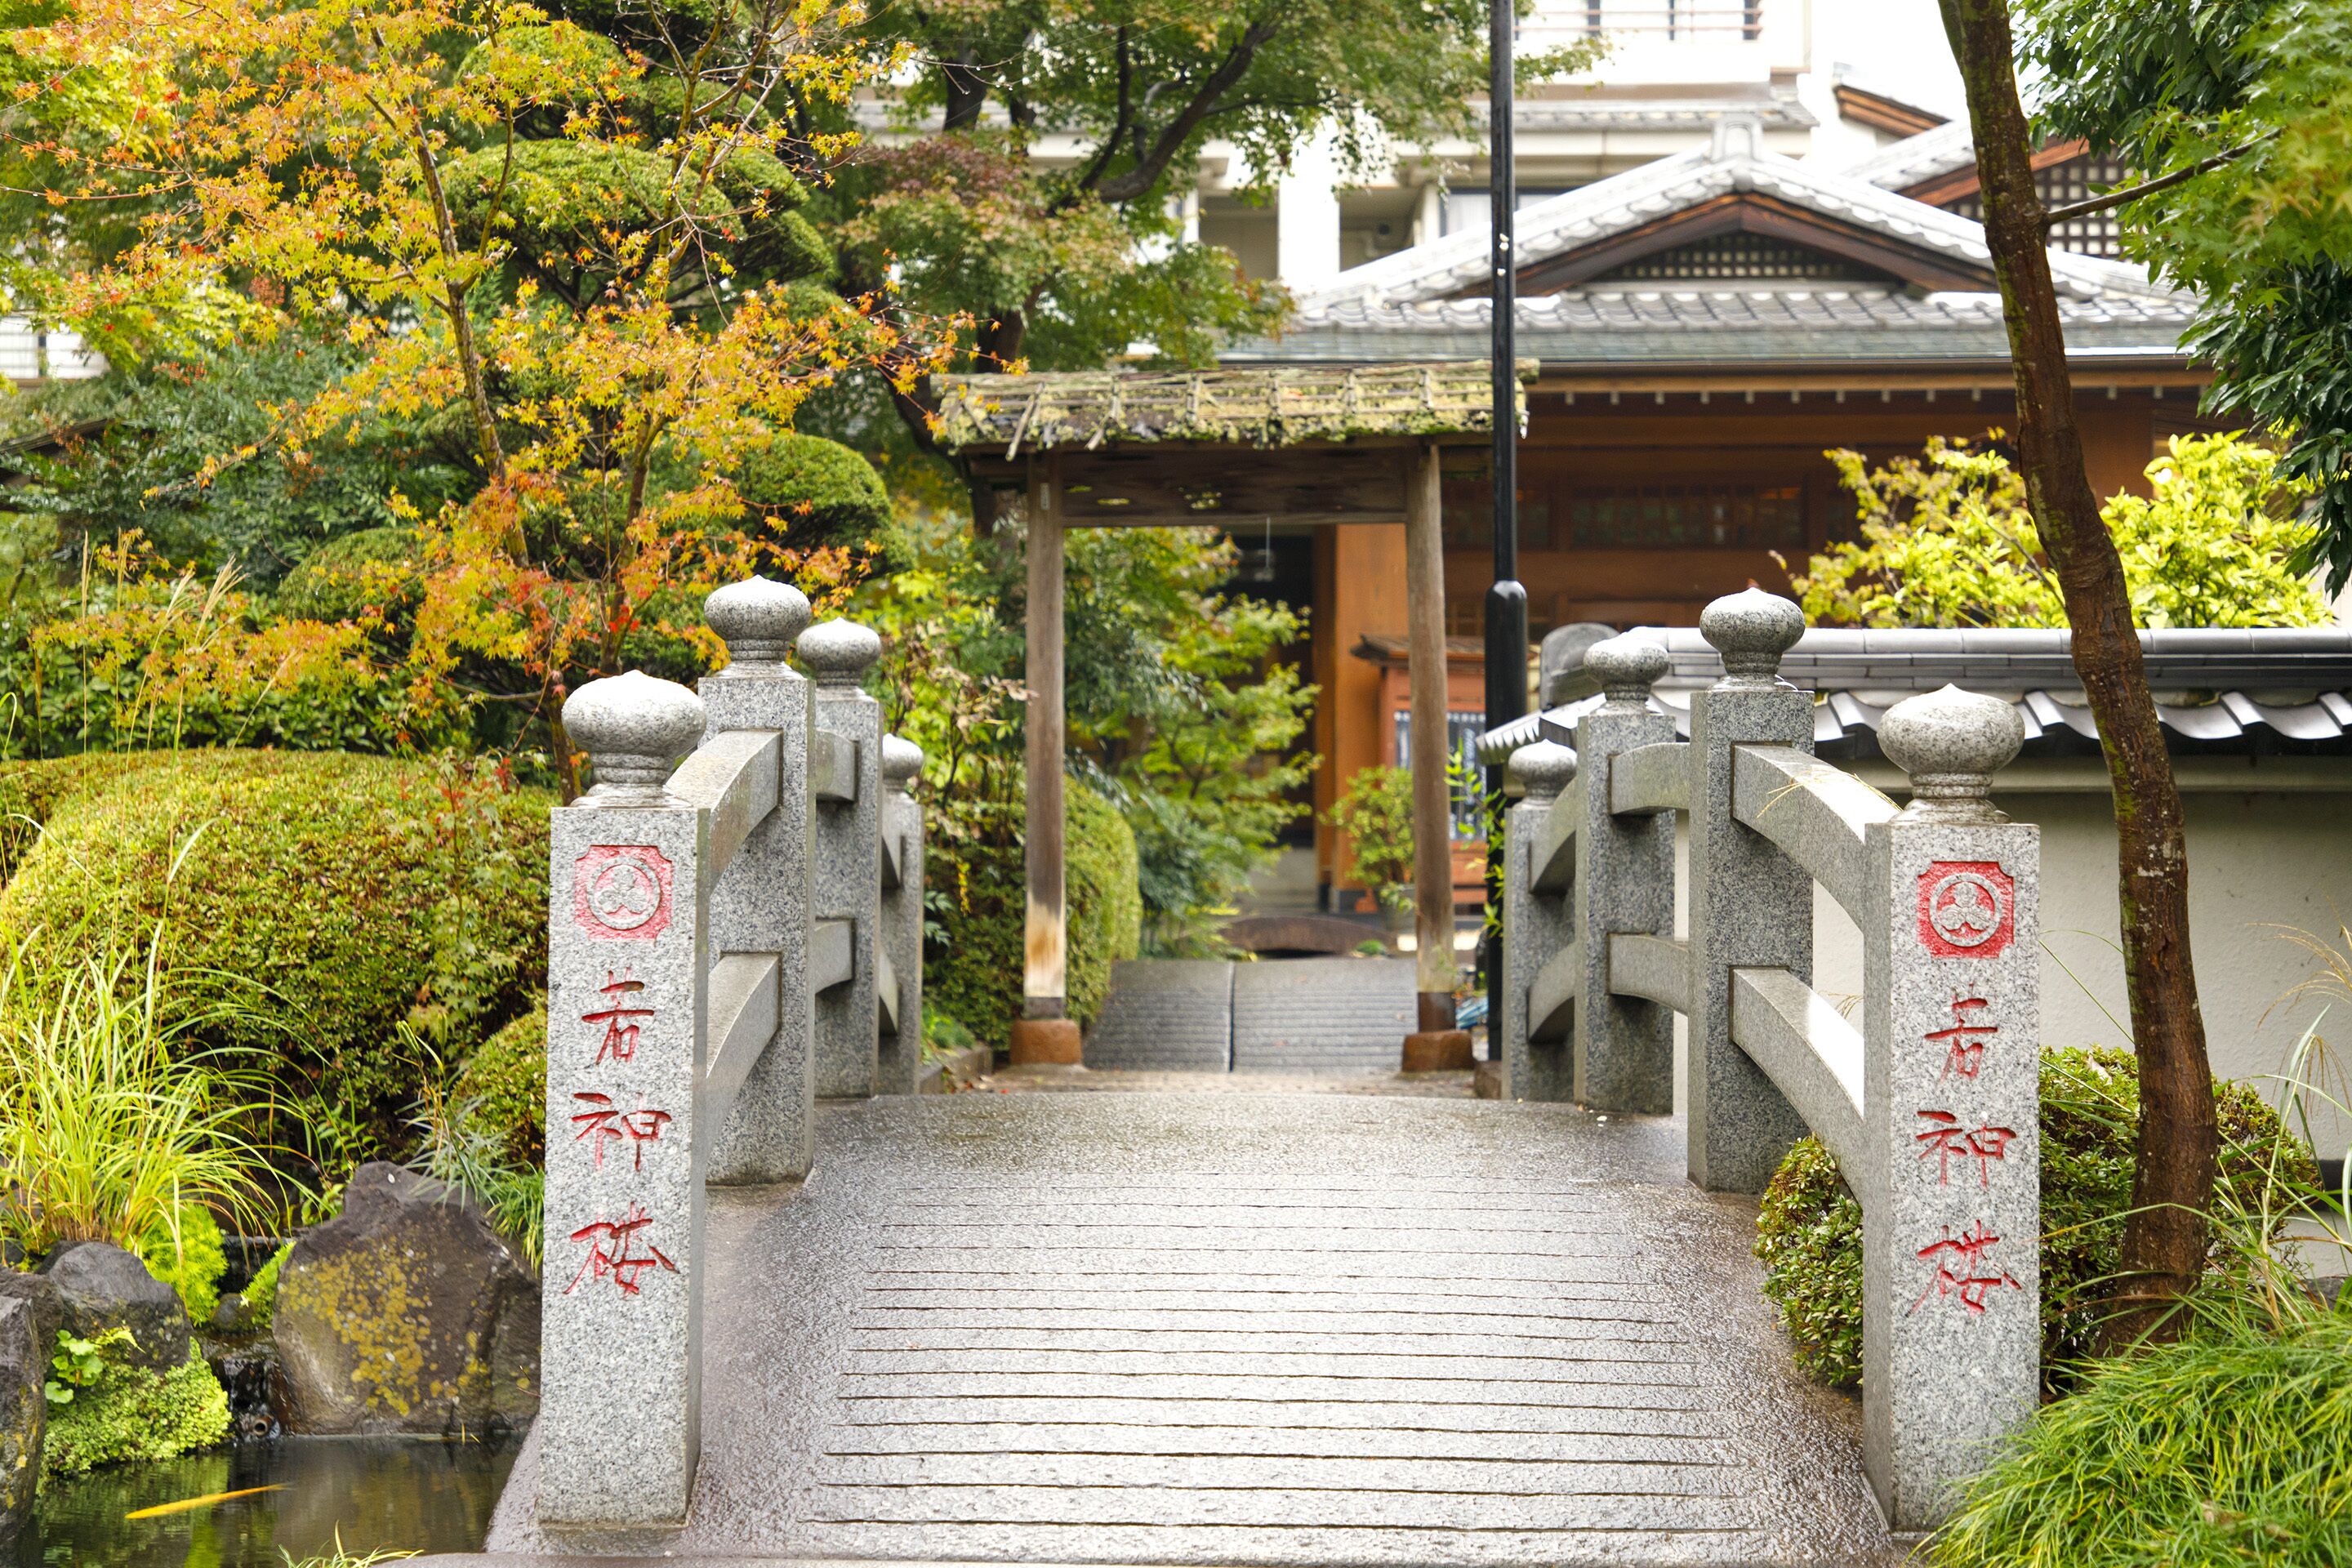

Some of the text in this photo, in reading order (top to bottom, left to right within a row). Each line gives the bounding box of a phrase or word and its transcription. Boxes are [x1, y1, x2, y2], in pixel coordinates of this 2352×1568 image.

[564, 966, 677, 1297] 若神楼
[1907, 984, 2021, 1316] 若神楼
